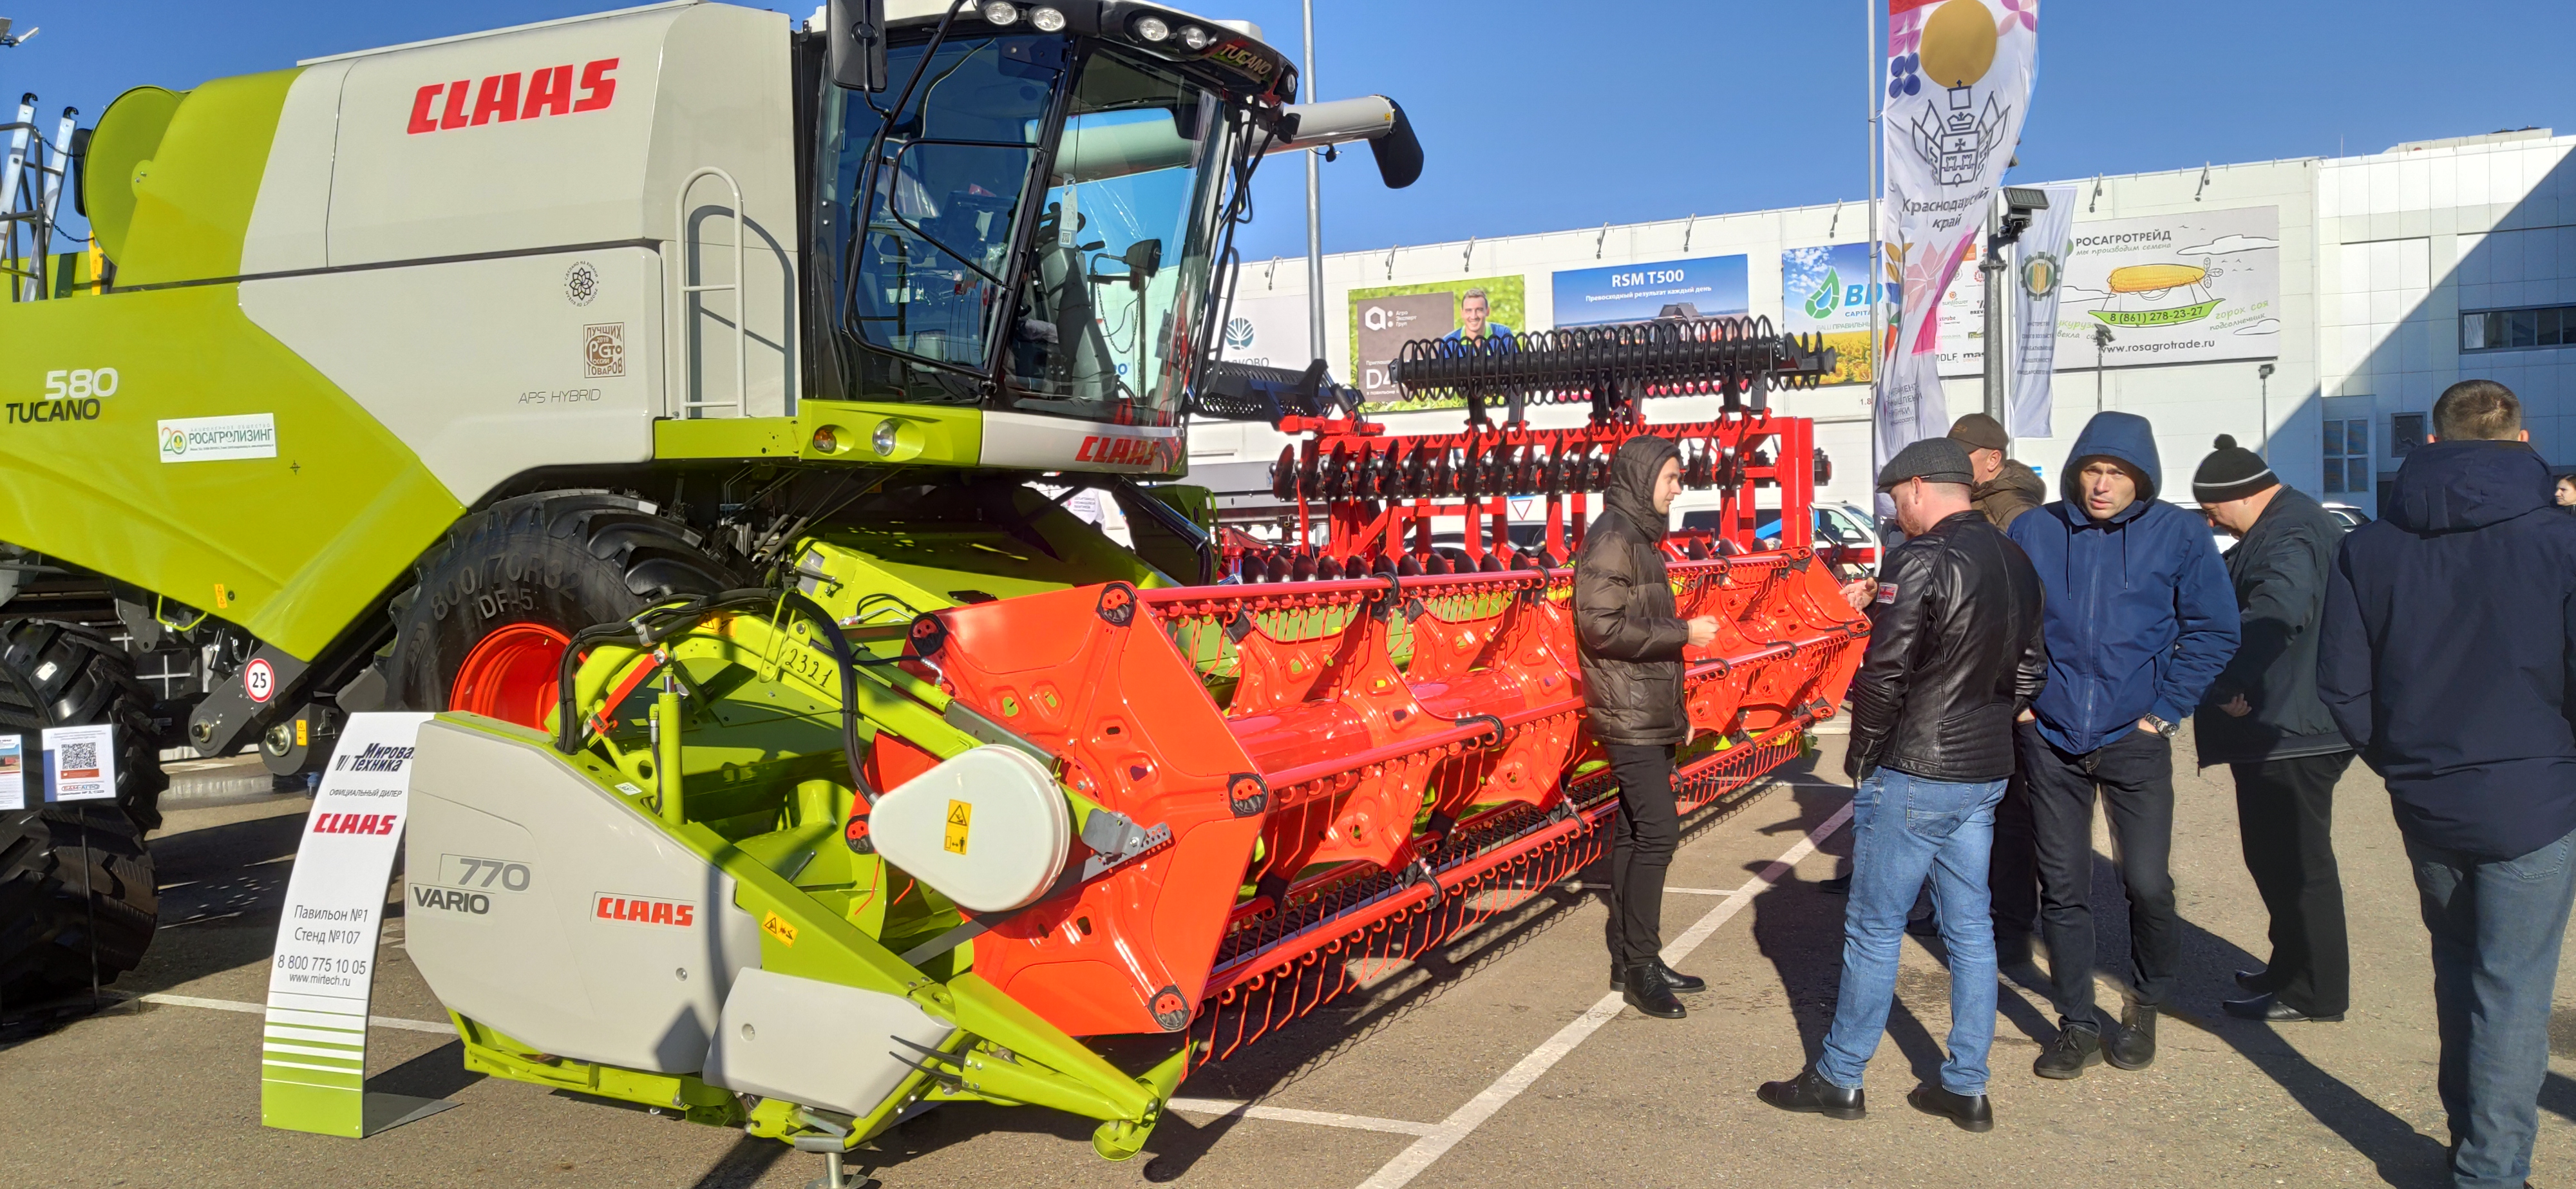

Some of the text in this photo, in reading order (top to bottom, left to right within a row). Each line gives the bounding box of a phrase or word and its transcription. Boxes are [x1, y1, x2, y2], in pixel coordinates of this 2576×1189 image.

[1220, 44, 1273, 75] TUCANO
[406, 57, 620, 135] CLAAS
[1932, 213, 1962, 233] край
[2076, 229, 2172, 247] РОСАГРОТРЕЙД
[2092, 245, 2139, 256] производим
[1612, 269, 1684, 287] RSM T500
[1586, 292, 1633, 302] Превосходный
[1634, 290, 1666, 299] результат
[1667, 287, 1694, 296] каждый
[2110, 307, 2203, 324] 8 (861) 278-23-27
[2215, 300, 2269, 320] горох соя
[1832, 321, 1871, 330] ПРАВИЛЬНЫ
[2210, 312, 2266, 331] подсолнечник
[585, 325, 622, 343] ЛУЧШИХ
[587, 357, 623, 376] ТОВАРОВ
[45, 368, 118, 400] 580
[518, 389, 601, 404] APS HYBRID
[6, 398, 100, 424] TUCANO
[1075, 435, 1162, 466] CLAAS
[430, 553, 583, 621] 800/70R32
[478, 588, 534, 619] DF-5
[785, 649, 833, 688] 2321
[252, 672, 267, 689] 25
[363, 743, 415, 759] Мирова
[350, 755, 403, 772] Техника
[313, 813, 397, 835] CLAAS
[458, 858, 531, 892] 770
[413, 886, 490, 915] VARIO
[294, 904, 368, 922] Павильон №1
[596, 897, 694, 927] CLAAS
[294, 927, 361, 945] Стенд №107
[278, 955, 366, 975] 8 800 775 10 05
[289, 973, 351, 987] www.mirtech.ru
